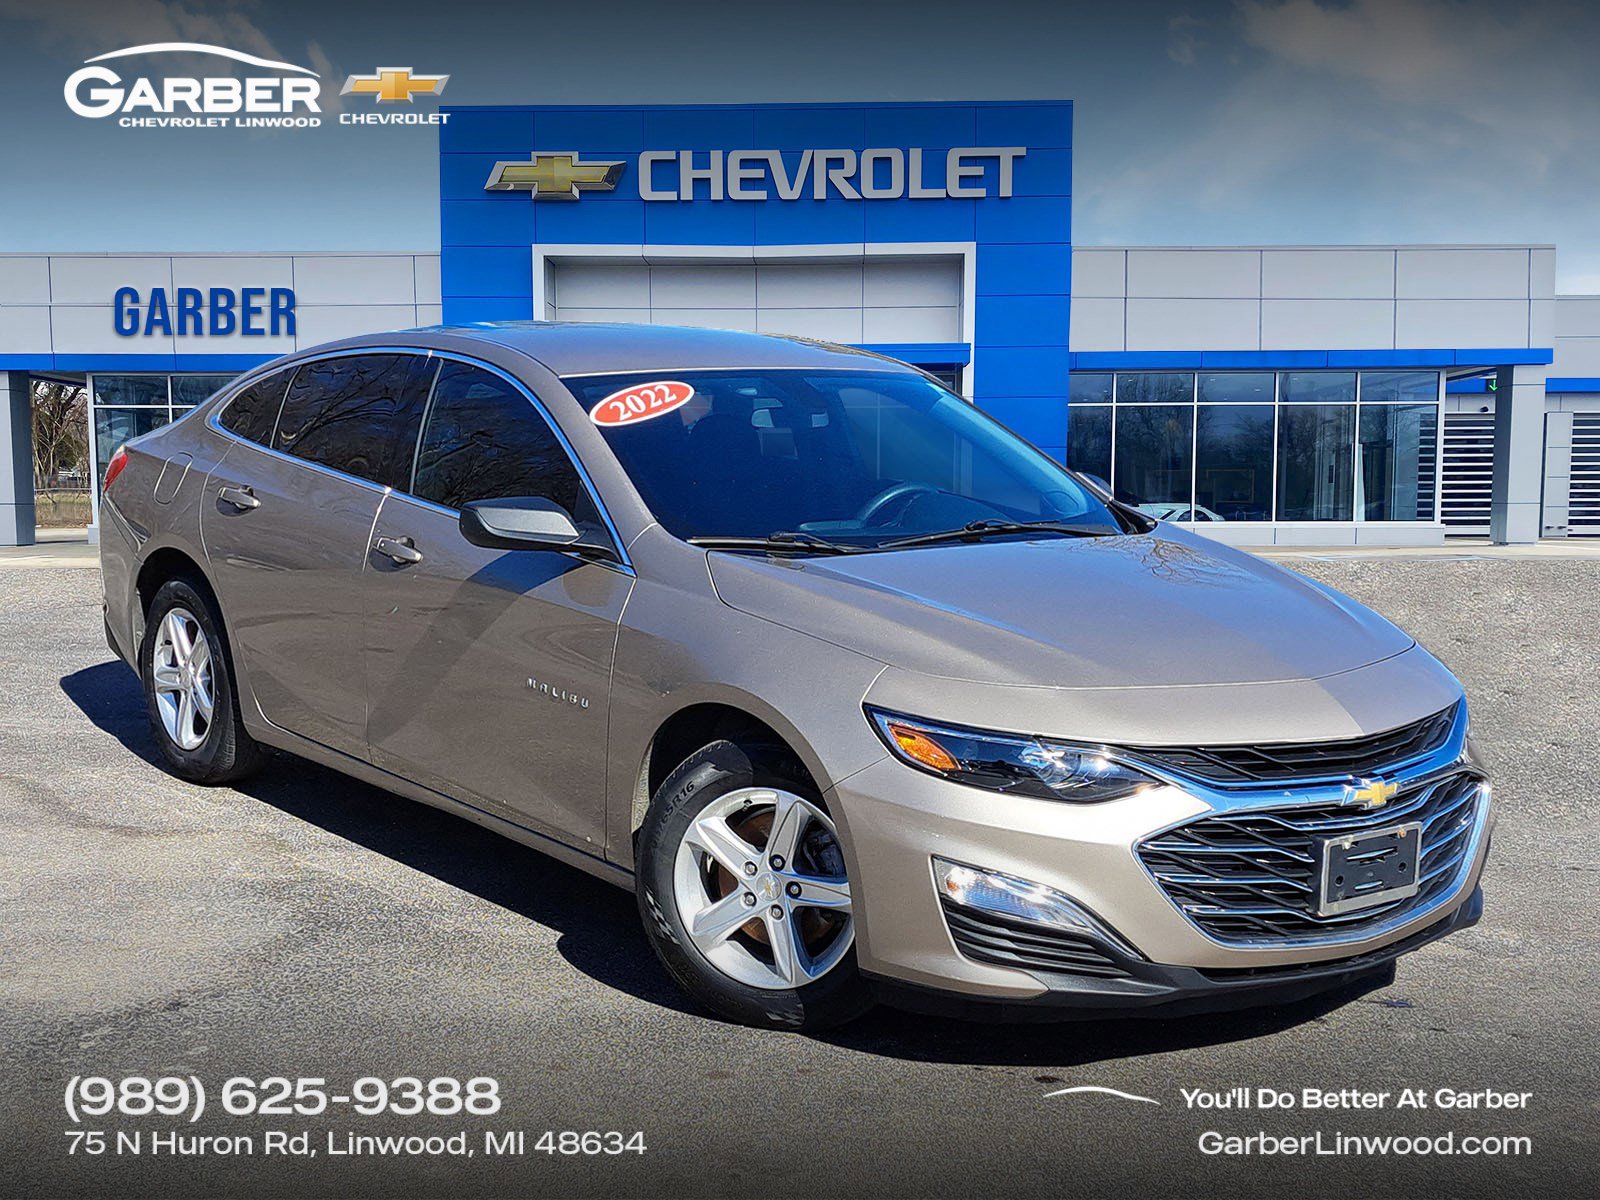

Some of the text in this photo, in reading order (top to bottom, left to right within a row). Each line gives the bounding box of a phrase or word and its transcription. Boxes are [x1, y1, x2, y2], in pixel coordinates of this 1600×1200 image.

[638, 147, 1027, 201] CHEVROLET
[113, 286, 297, 337] GARBER
[609, 385, 677, 421] 2022
[526, 677, 590, 709] MALIBU
